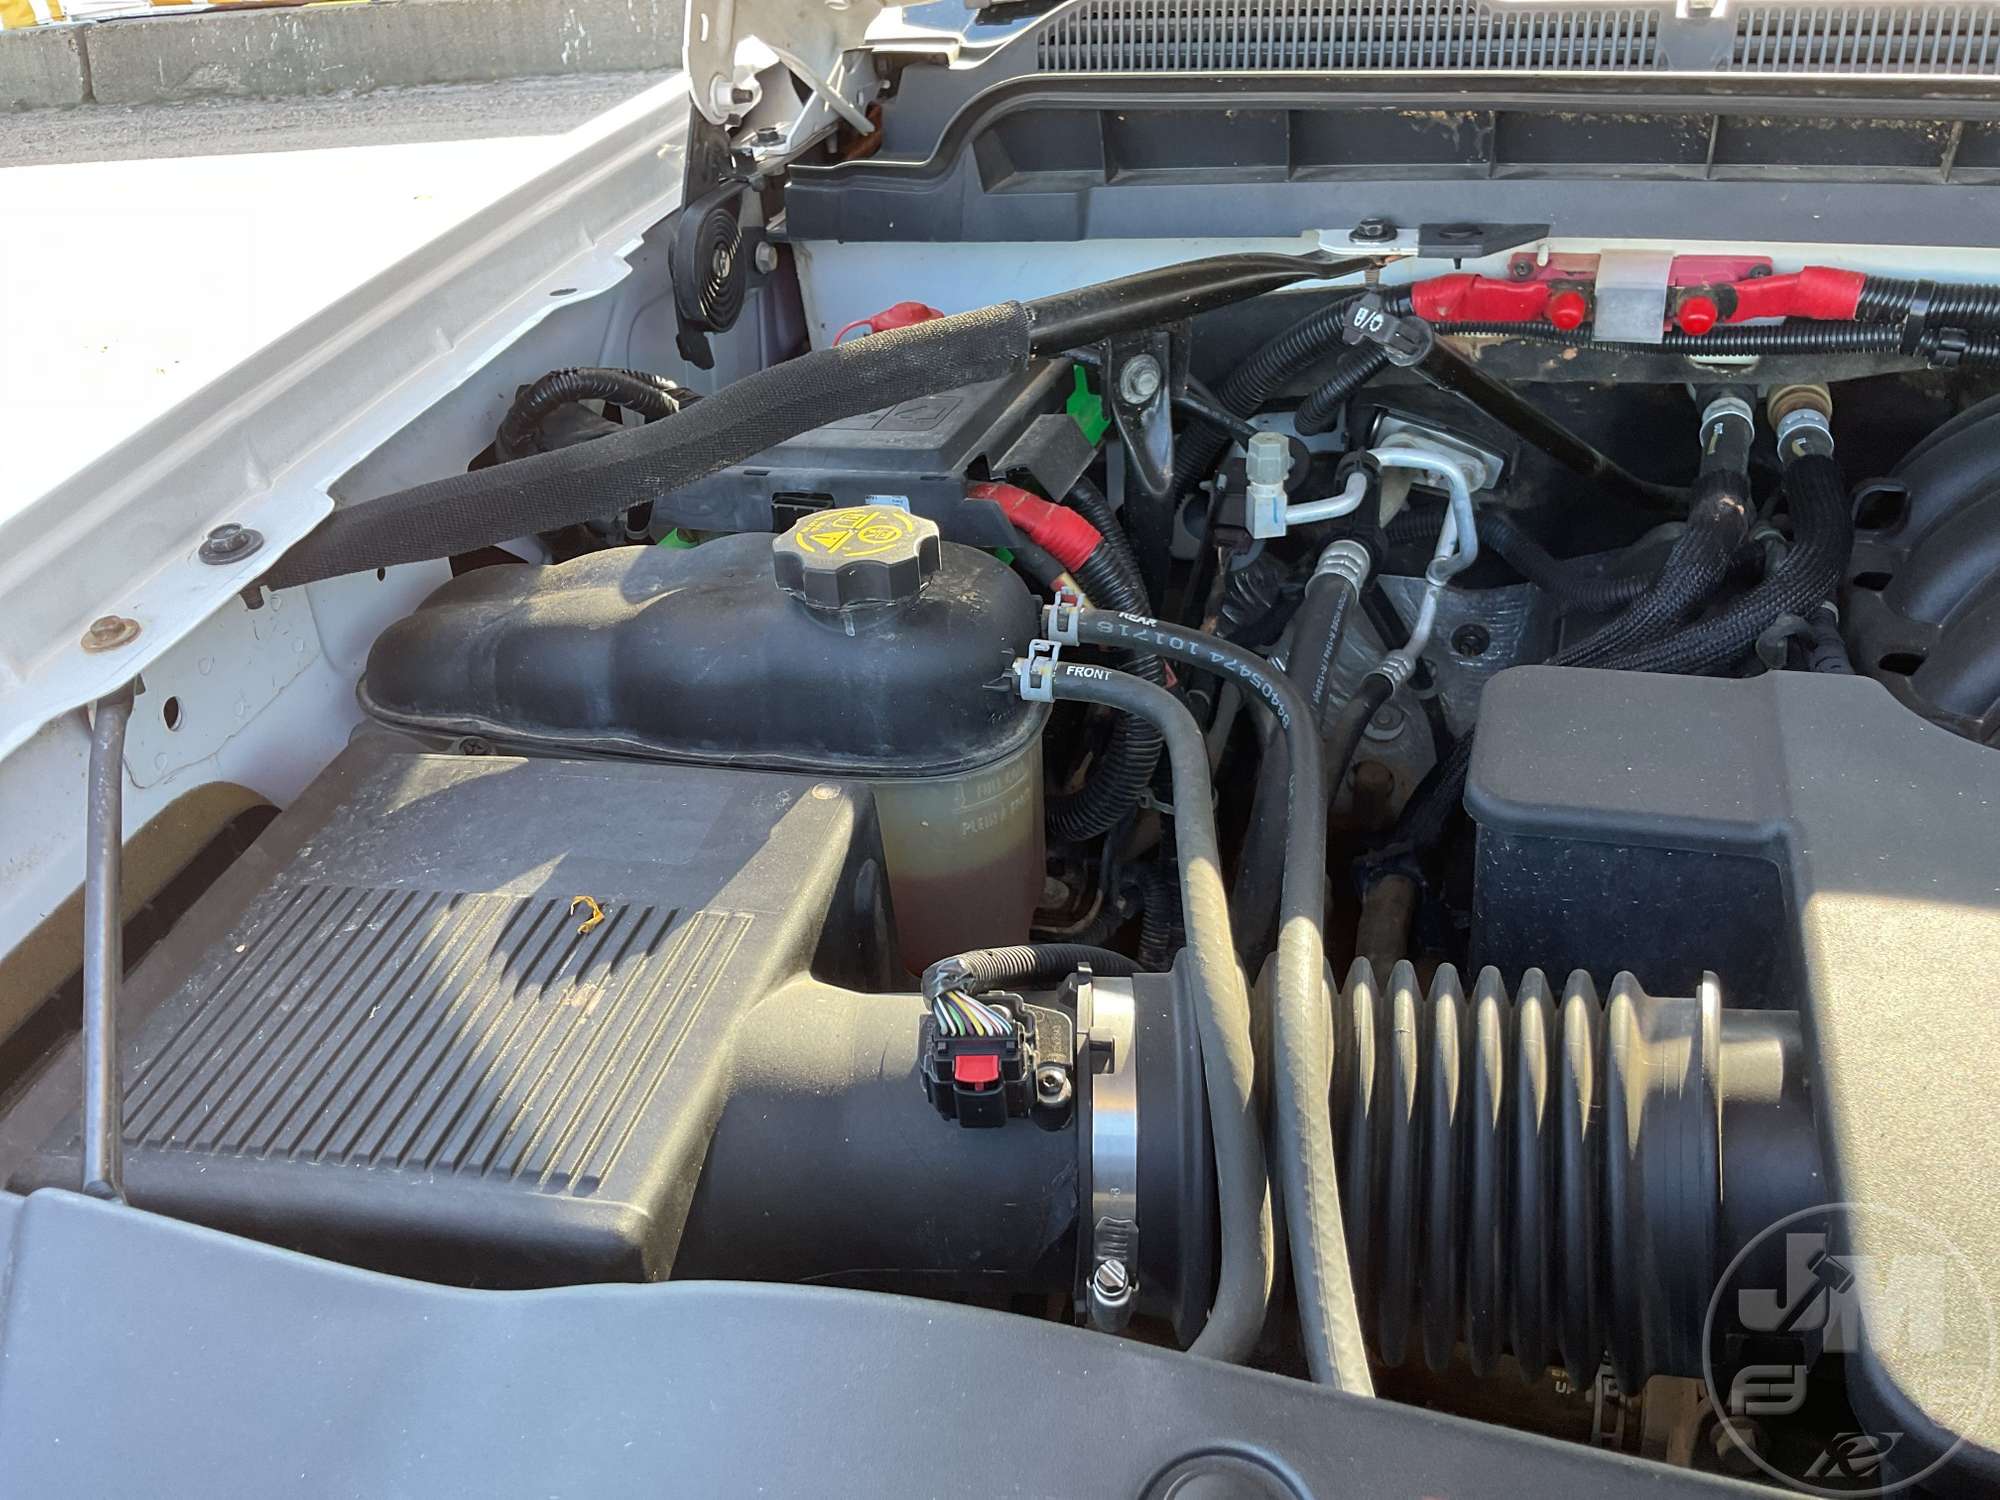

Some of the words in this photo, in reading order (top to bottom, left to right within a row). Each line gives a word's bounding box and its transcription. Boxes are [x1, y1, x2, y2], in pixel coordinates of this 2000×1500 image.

[1097, 621, 1199, 655] 101718
[1066, 665, 1113, 681] FRONT
[1209, 651, 1290, 729] 84405474
